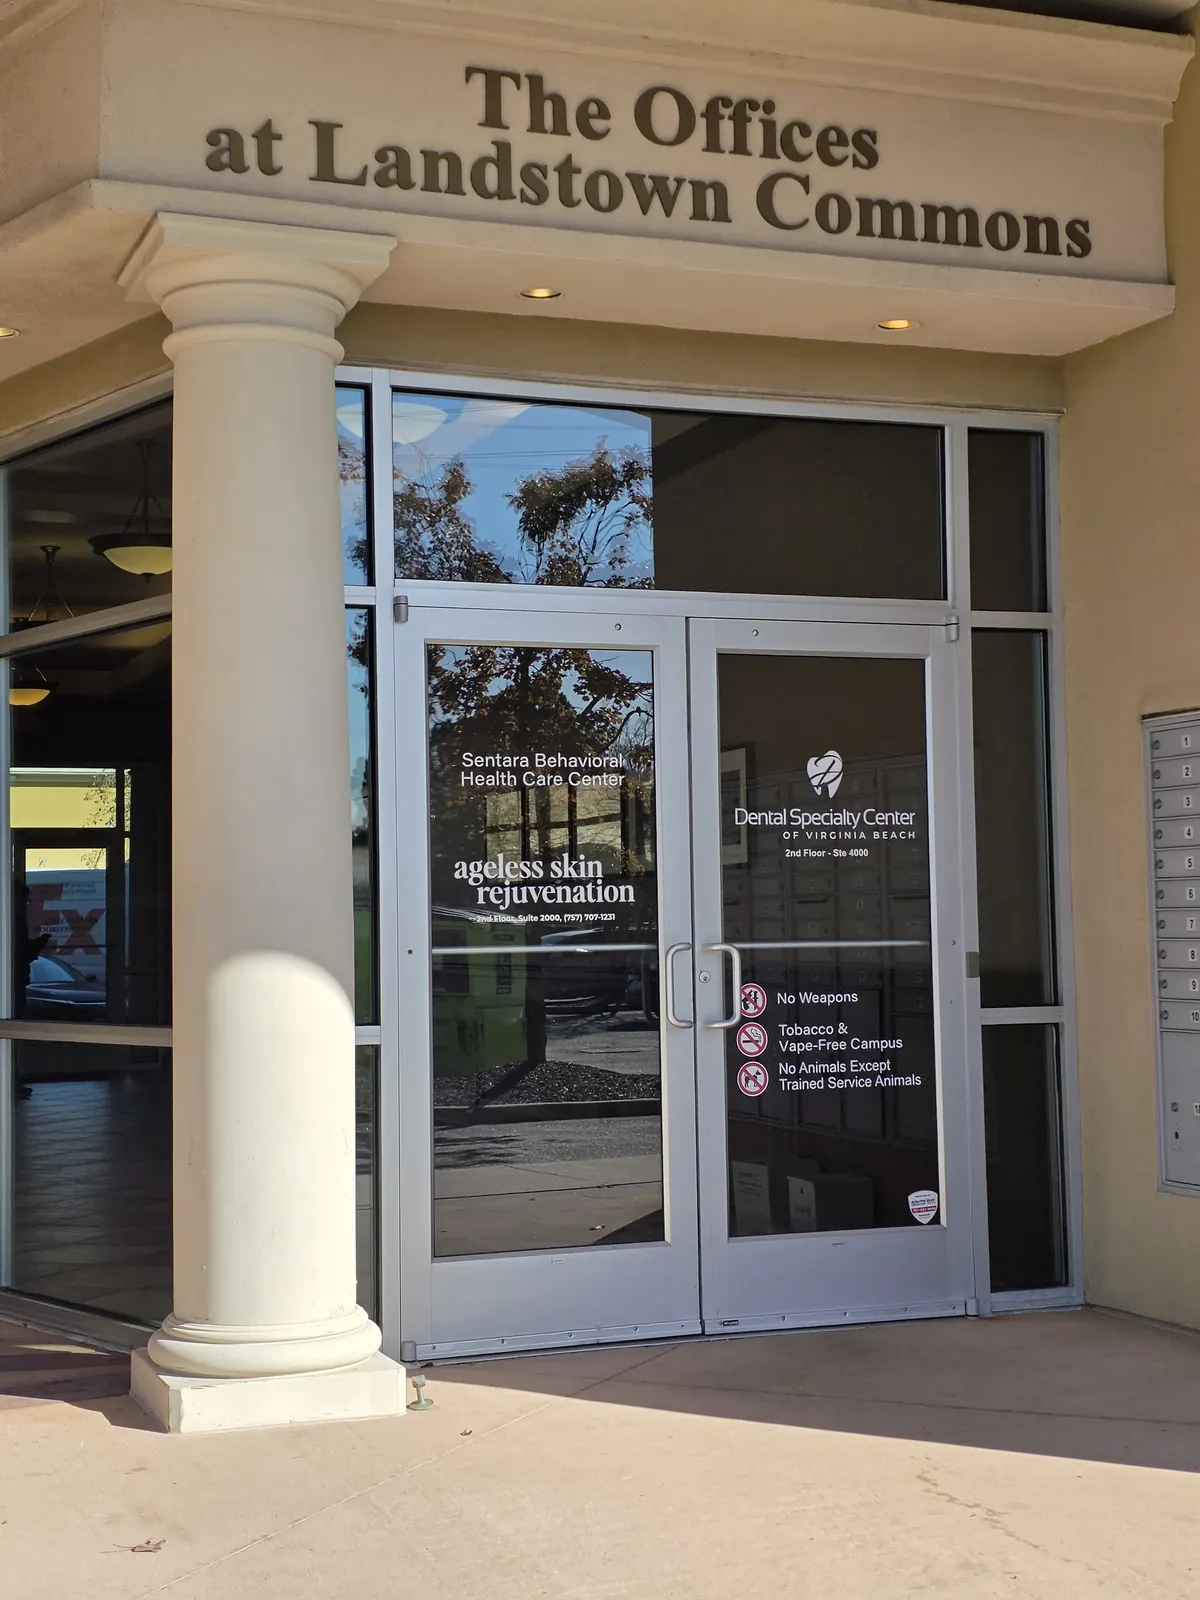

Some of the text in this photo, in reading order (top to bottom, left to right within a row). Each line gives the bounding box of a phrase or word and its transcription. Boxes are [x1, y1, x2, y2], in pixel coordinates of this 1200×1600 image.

[465, 66, 879, 170] The Offices
[205, 118, 1092, 258] at Landstown Commons
[462, 752, 623, 768] Sentara Behavioral
[461, 771, 625, 787] Health Care Center
[734, 808, 915, 829] Dental Specialty Center
[783, 831, 915, 840] OF VIRGINIA BEACH
[785, 849, 801, 857] 2nd
[803, 849, 826, 857] Floor
[833, 849, 847, 857] Ste
[848, 849, 868, 857] 4000
[454, 853, 603, 886] ageless skin
[477, 879, 635, 910] rejuvenation
[518, 914, 538, 922] Suite
[540, 914, 562, 922] 2000,
[564, 913, 583, 922] (757)
[584, 913, 616, 921] 707-1231
[777, 992, 858, 1006] No Weapons
[1191, 1012, 1199, 1021] 10
[779, 1022, 848, 1037] Tobacco &
[779, 1037, 903, 1054] Vape-Free Campus
[779, 1059, 891, 1075] No Animals Except
[779, 1074, 921, 1091] Trained Service Animals
